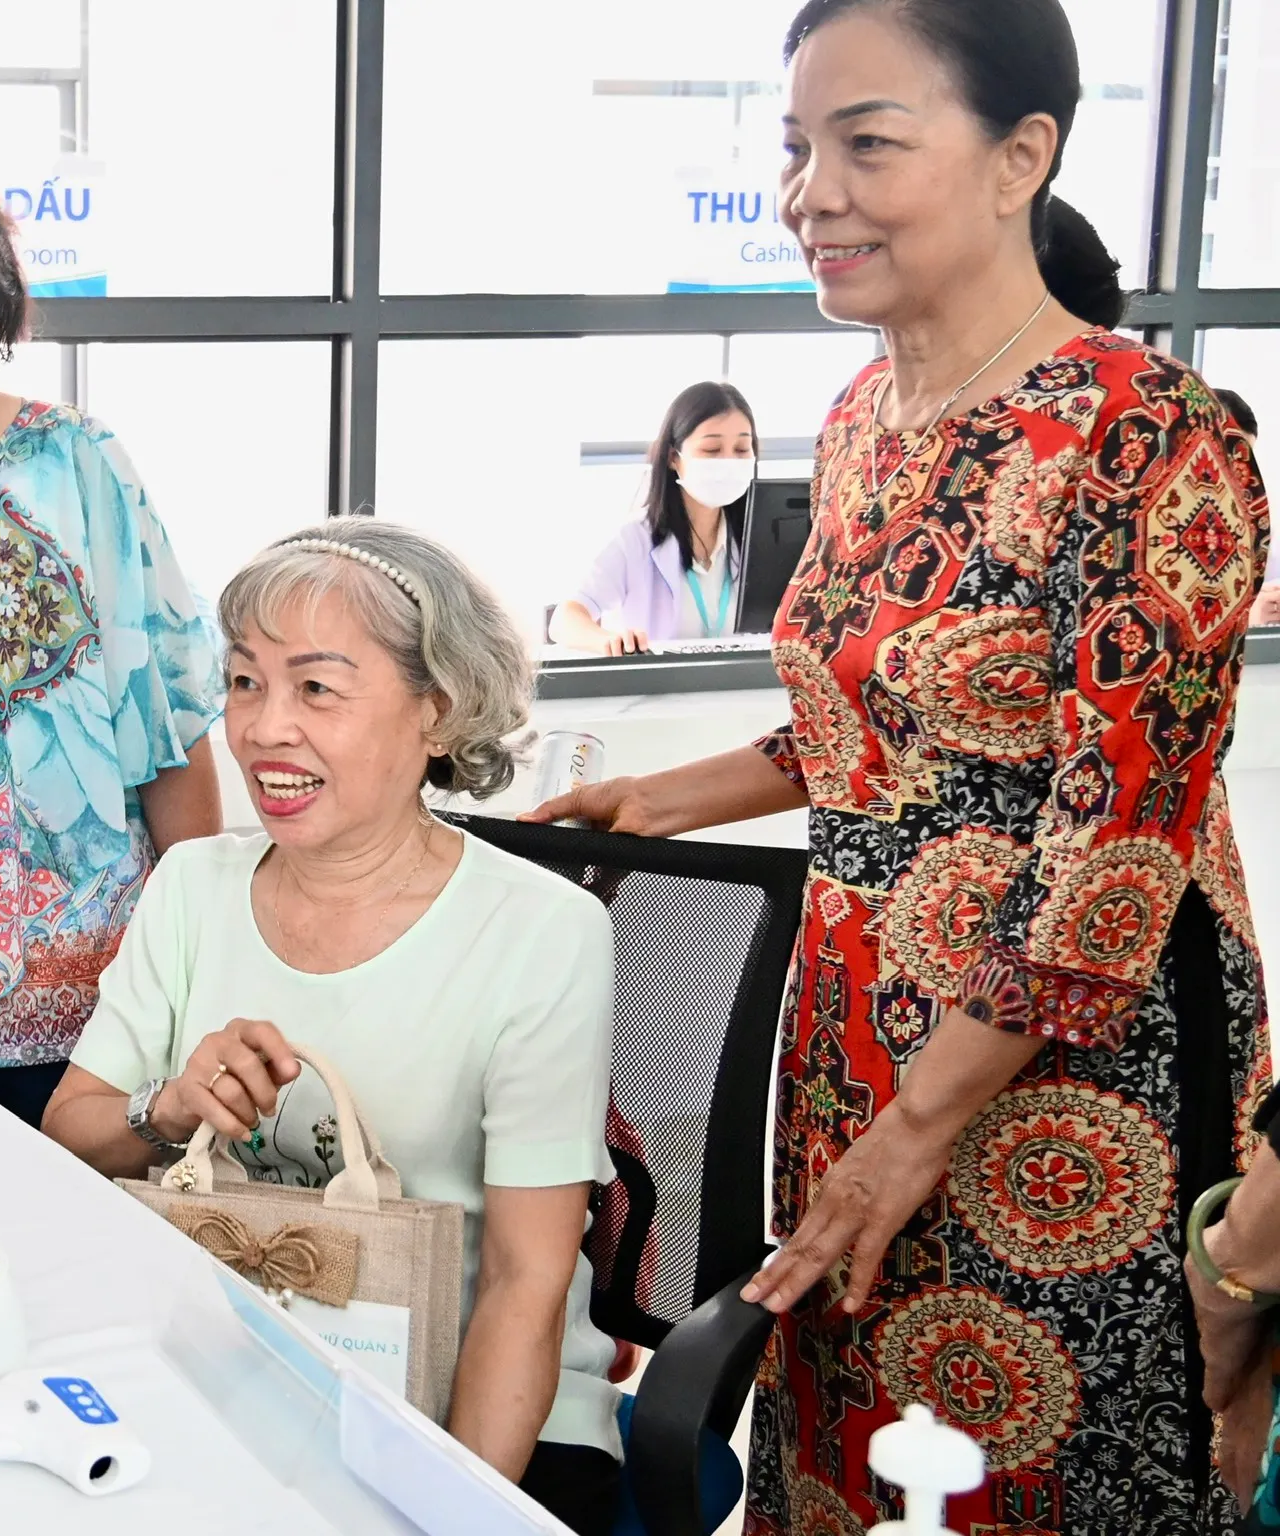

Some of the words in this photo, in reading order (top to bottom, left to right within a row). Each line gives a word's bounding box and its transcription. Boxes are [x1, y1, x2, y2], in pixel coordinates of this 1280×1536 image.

[4, 176, 91, 221] DẤU
[687, 192, 761, 223] THU
[23, 248, 78, 266] oom
[391, 1343, 401, 1355] 3
